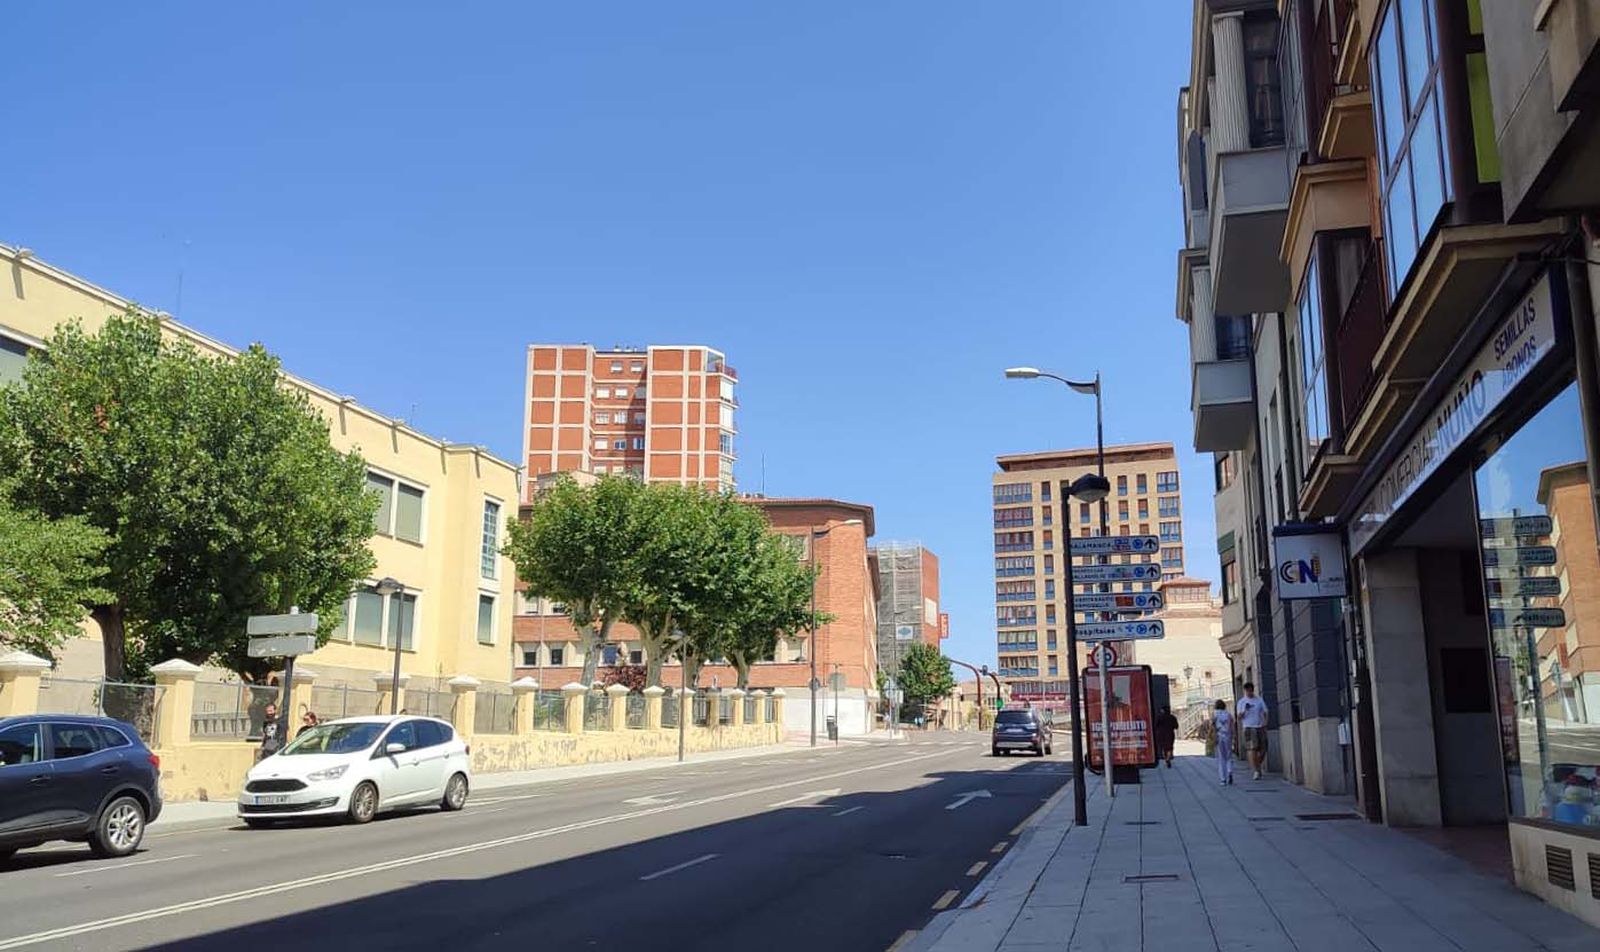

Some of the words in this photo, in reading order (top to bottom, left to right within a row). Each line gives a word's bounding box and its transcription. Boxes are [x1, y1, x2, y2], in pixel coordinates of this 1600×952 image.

[1494, 297, 1537, 361] SEMILLAS
[1502, 335, 1538, 391] ABONOS
[1437, 369, 1486, 448] NUÑO
